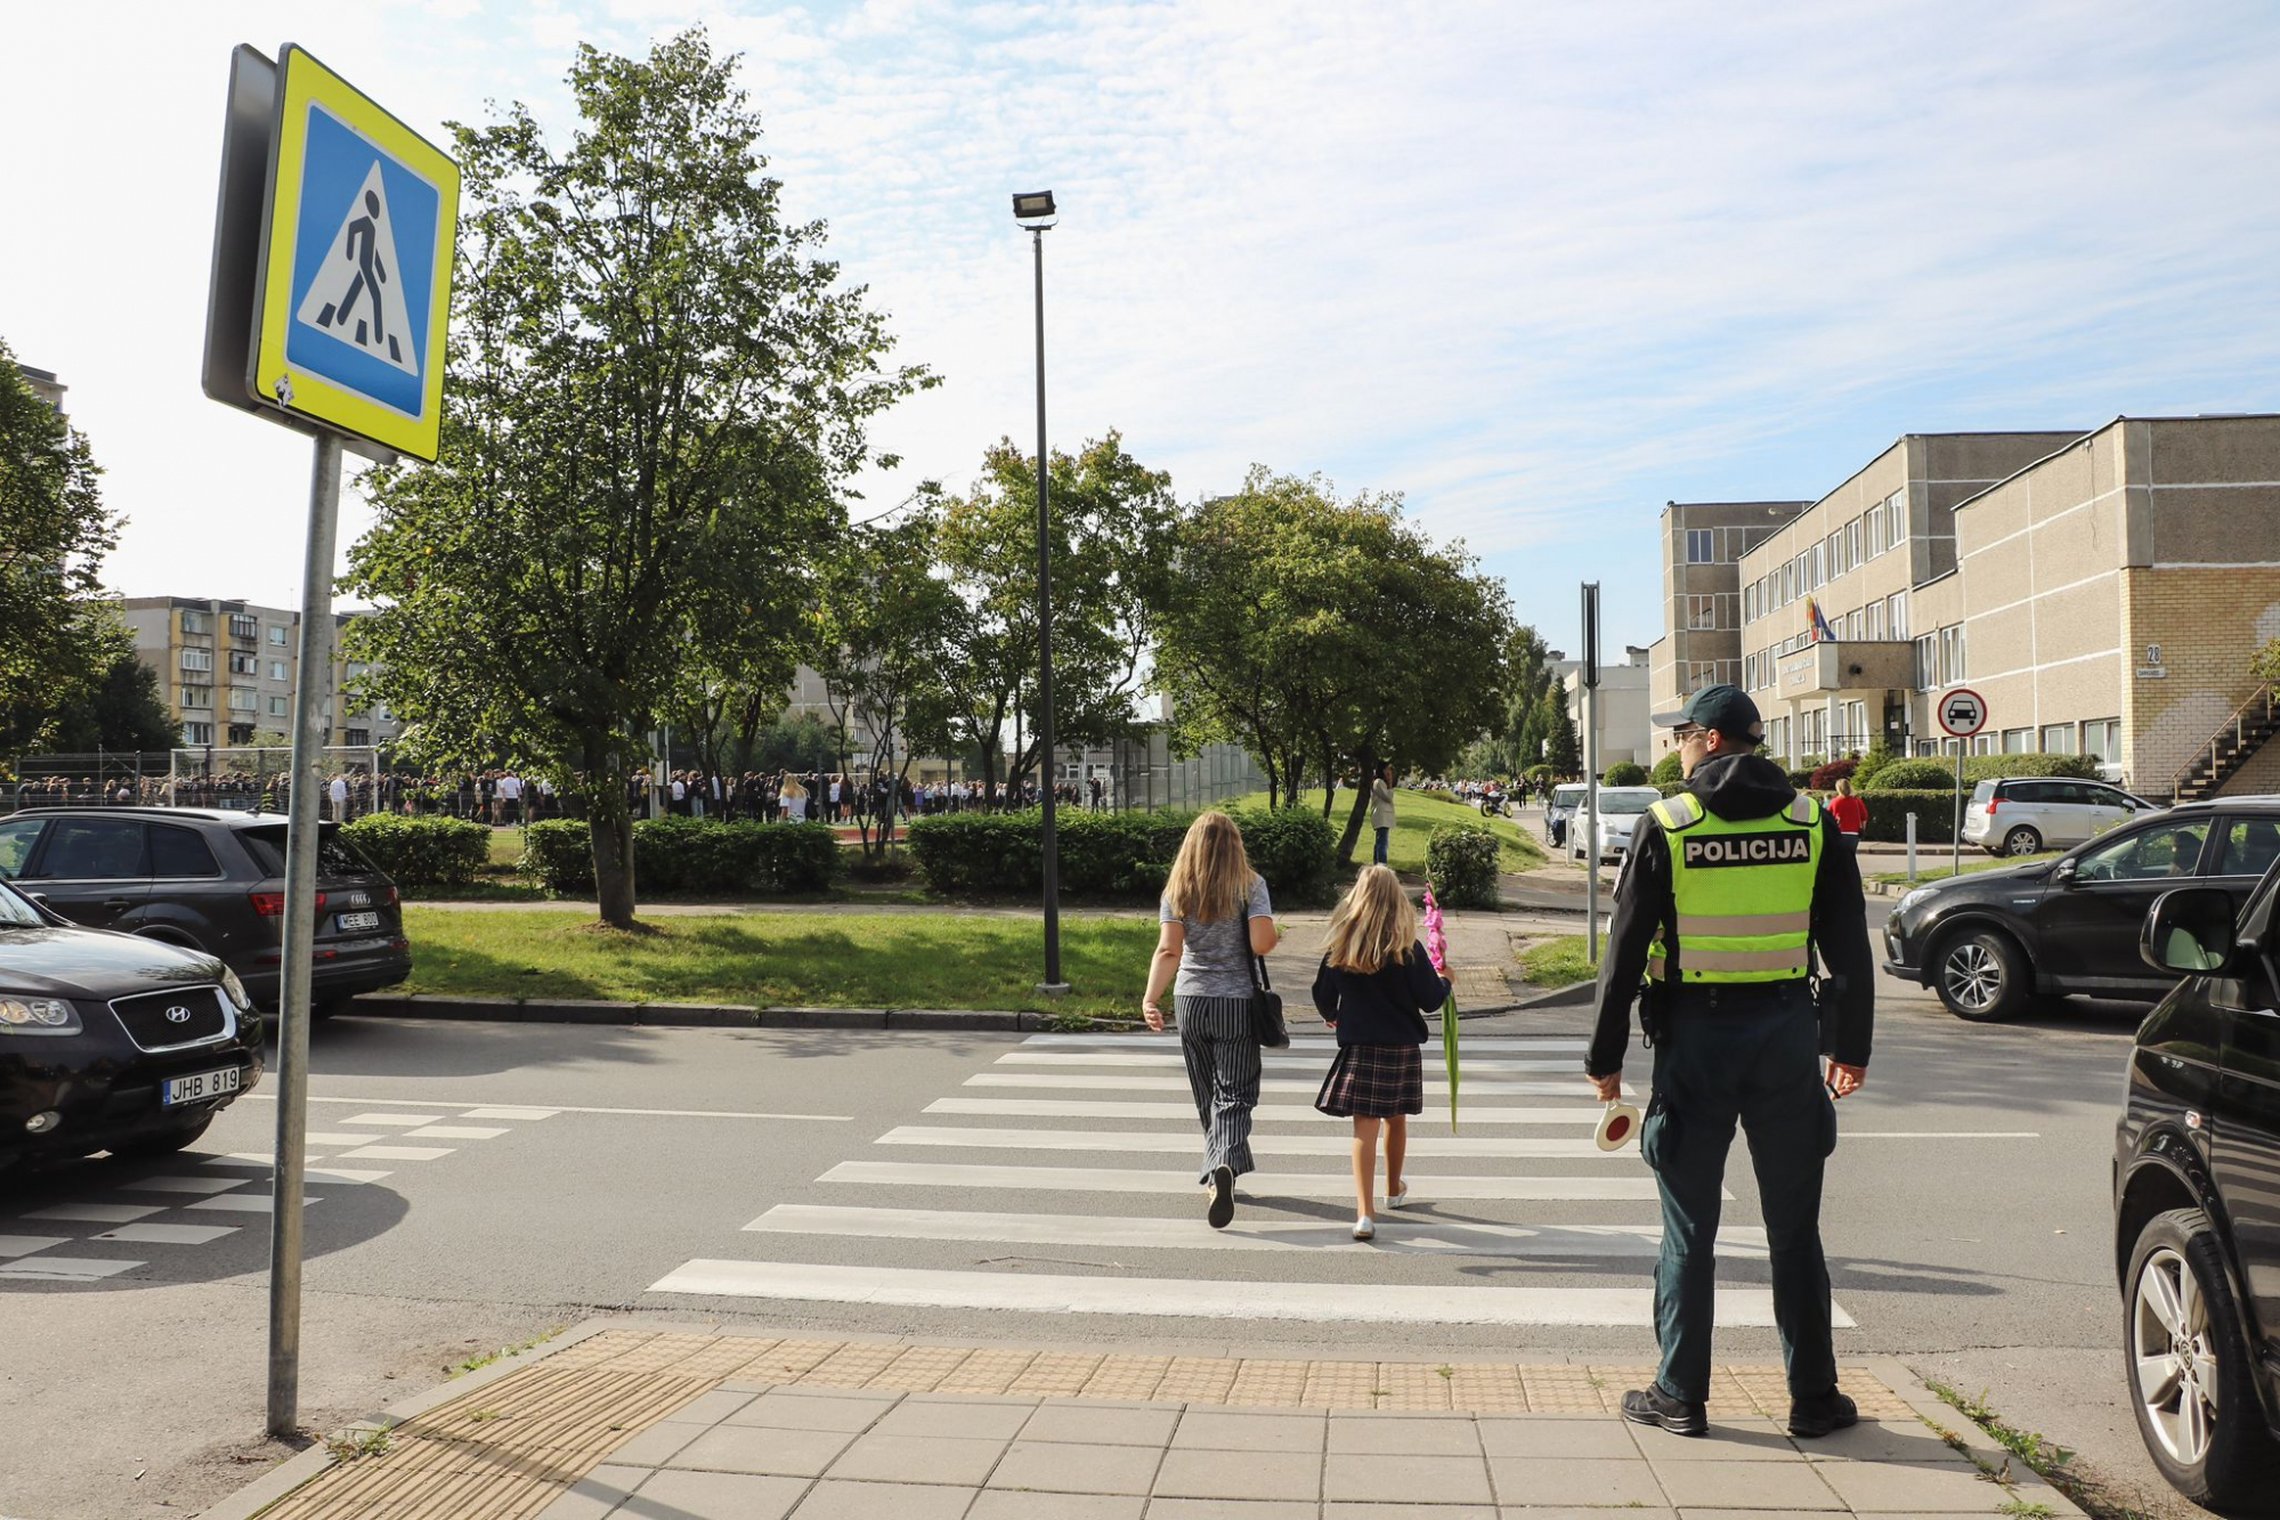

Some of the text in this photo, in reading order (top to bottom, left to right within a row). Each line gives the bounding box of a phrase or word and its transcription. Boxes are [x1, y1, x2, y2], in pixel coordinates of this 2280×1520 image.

[2148, 646, 2160, 662] 28
[1686, 838, 1808, 862] POLICIJA
[172, 1077, 203, 1101] JHB
[212, 1070, 238, 1092] 819
